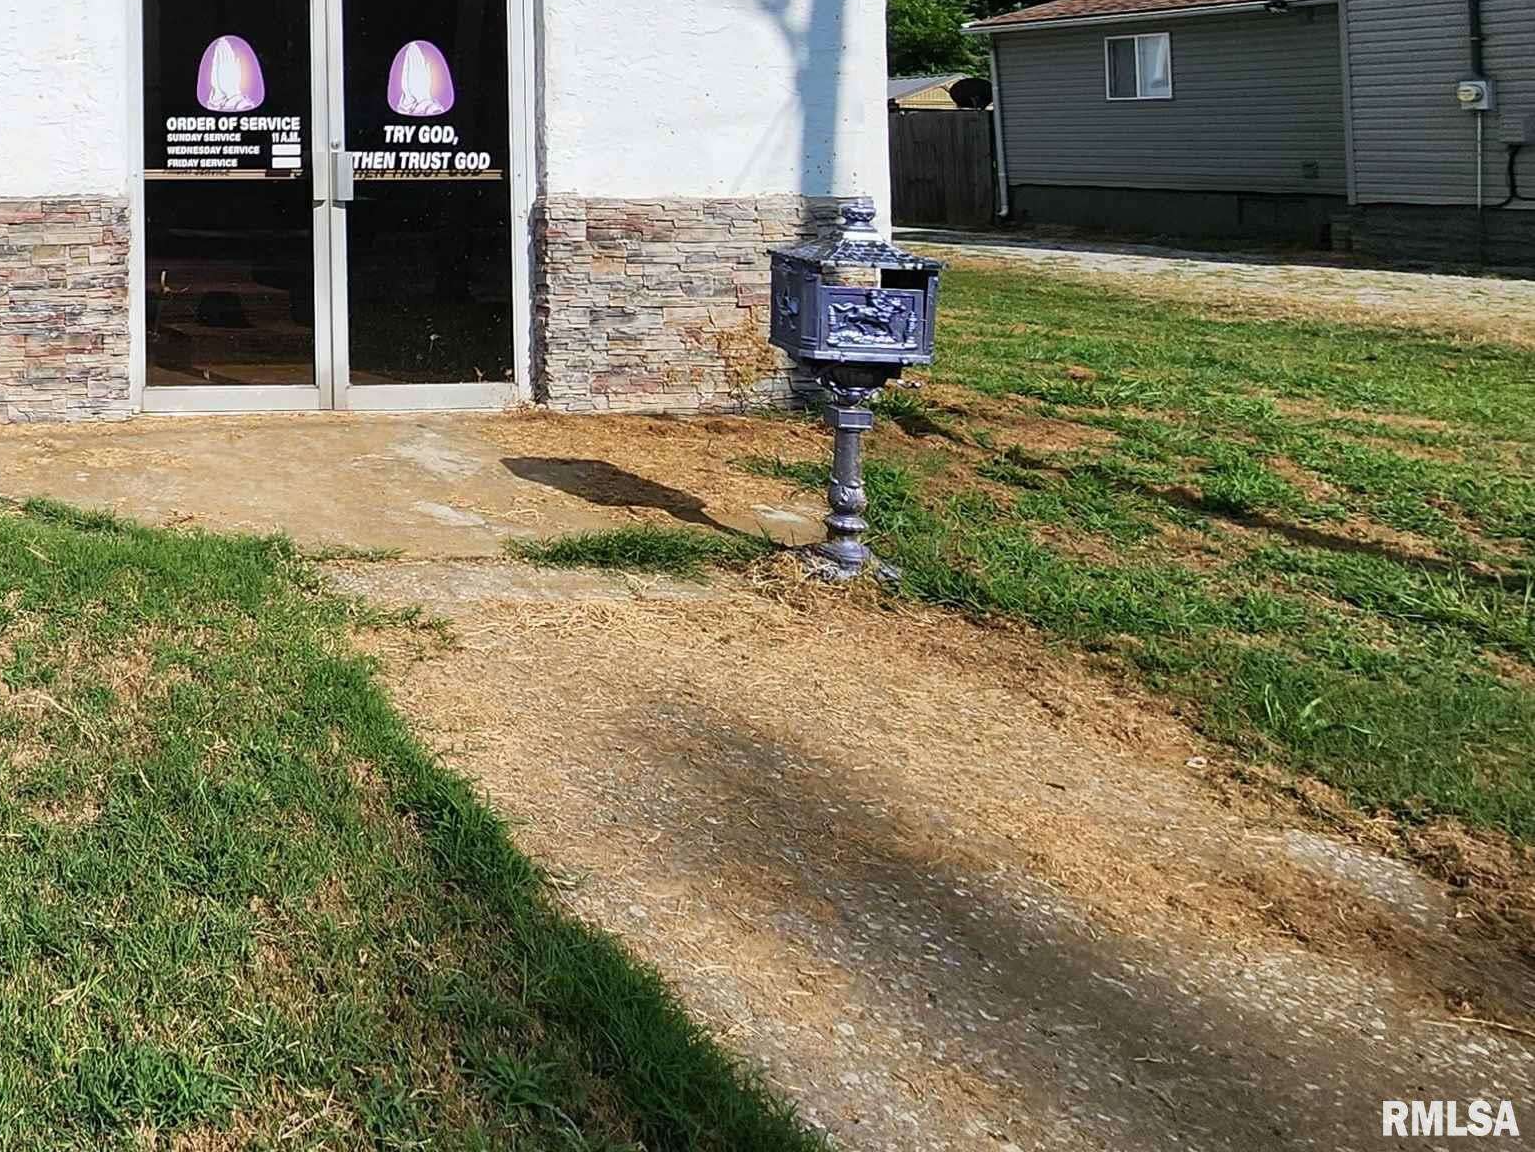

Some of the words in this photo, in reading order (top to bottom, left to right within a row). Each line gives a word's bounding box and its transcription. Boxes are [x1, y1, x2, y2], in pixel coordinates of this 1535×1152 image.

[166, 116, 216, 131] ORDER
[217, 116, 238, 131] OF
[239, 116, 301, 131] SERVICE
[166, 133, 203, 142] SUNDAY
[203, 132, 242, 142] SERVICE
[271, 132, 280, 143] 11
[280, 131, 301, 143] A.M.
[383, 125, 417, 144] TRY
[418, 125, 459, 146] GOD,
[166, 146, 221, 155] WEDNESDAY
[222, 146, 261, 155] SERVICE
[166, 158, 200, 167] FRIDAY
[200, 158, 239, 167] SERVICE
[352, 151, 396, 170] THEN
[399, 151, 452, 170] TRUST
[453, 151, 491, 170] GOD
